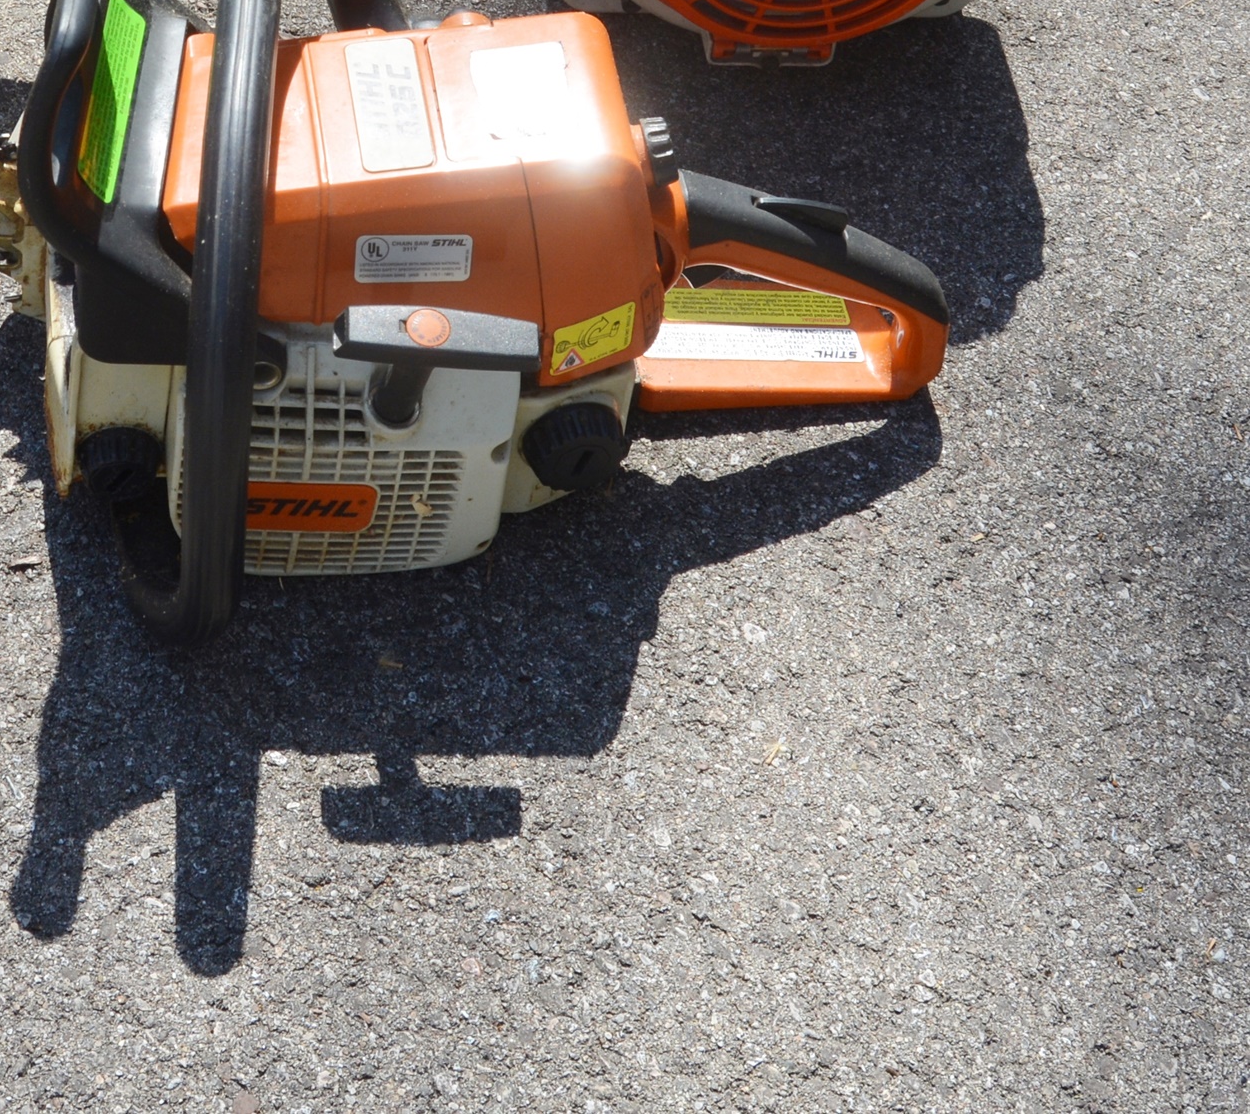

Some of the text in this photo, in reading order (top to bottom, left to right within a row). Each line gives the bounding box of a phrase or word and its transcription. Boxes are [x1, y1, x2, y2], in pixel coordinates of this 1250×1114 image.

[431, 239, 467, 247] STIHL
[814, 350, 858, 359] STIHL
[247, 497, 359, 518] STIHL
